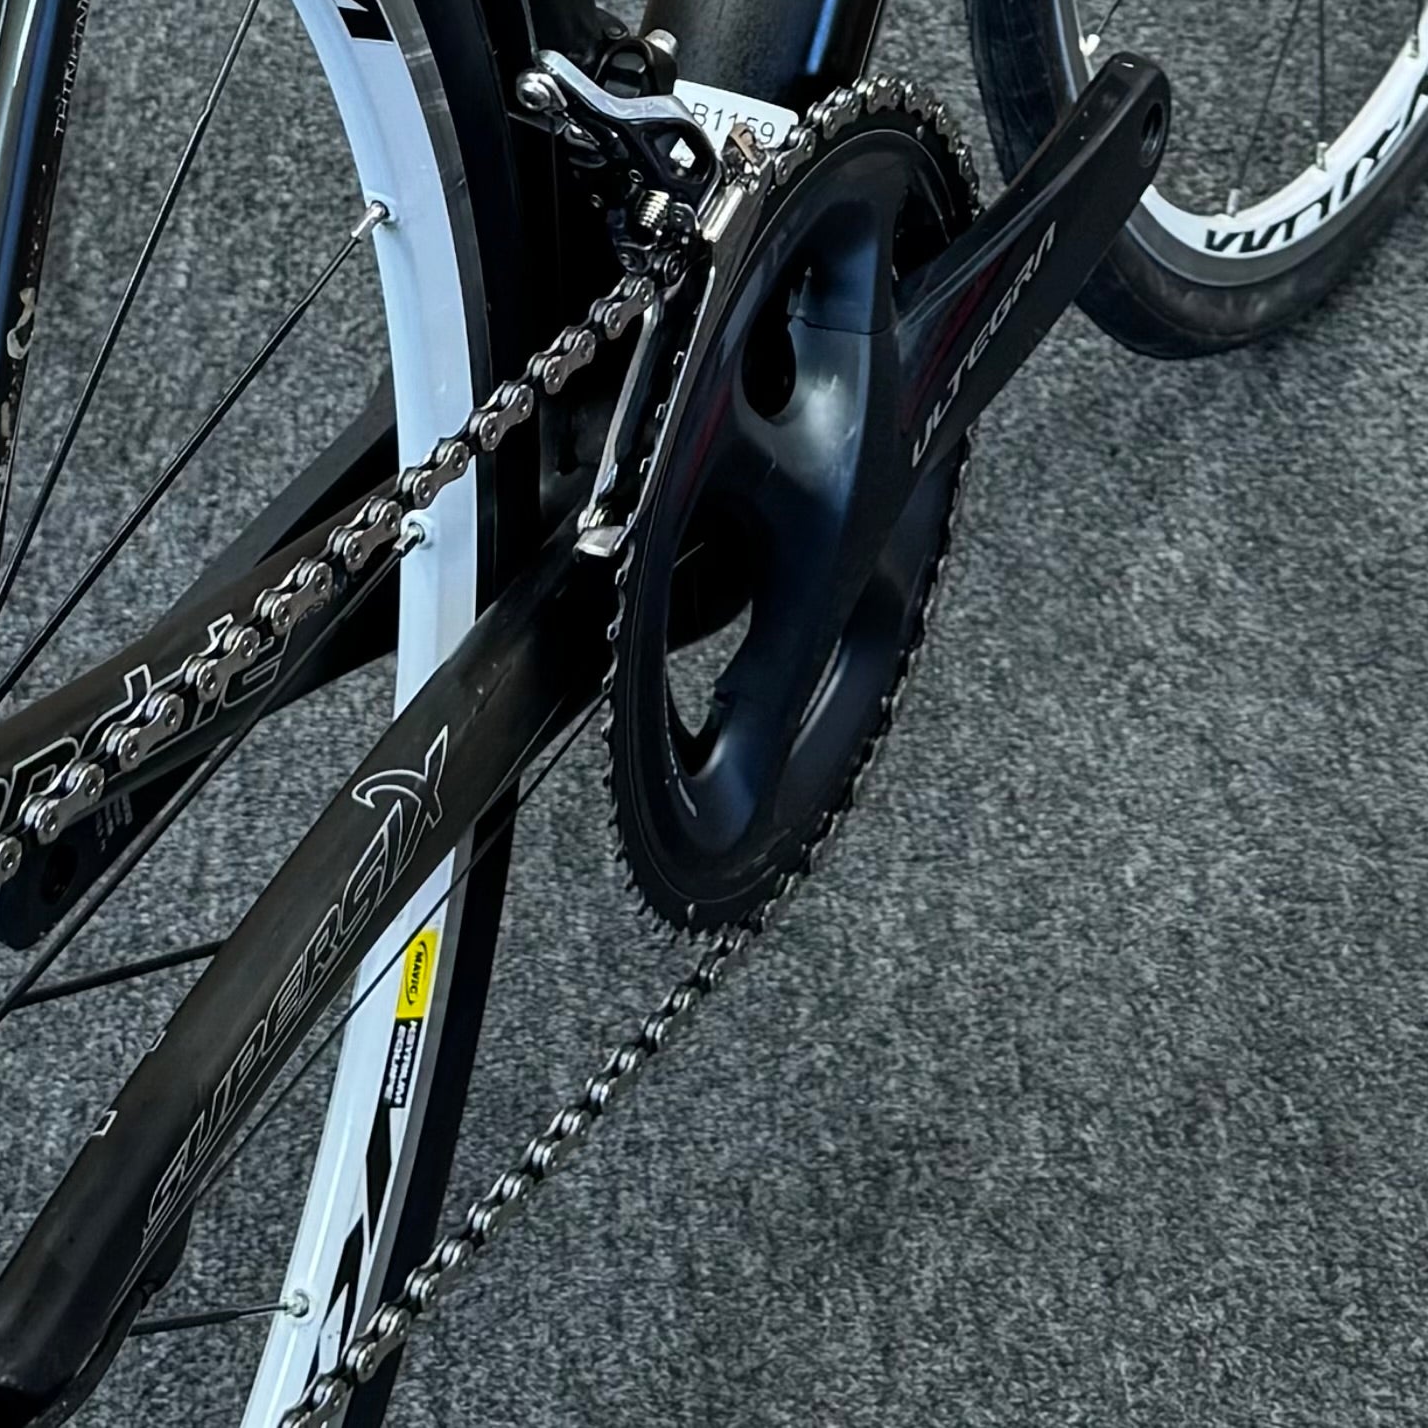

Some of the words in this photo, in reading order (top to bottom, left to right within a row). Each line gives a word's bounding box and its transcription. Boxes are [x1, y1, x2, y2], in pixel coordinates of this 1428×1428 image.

[912, 222, 1057, 468] ULTEGRA
[142, 725, 449, 1241] SUPERSIX
[407, 950, 423, 996] MAVIC
